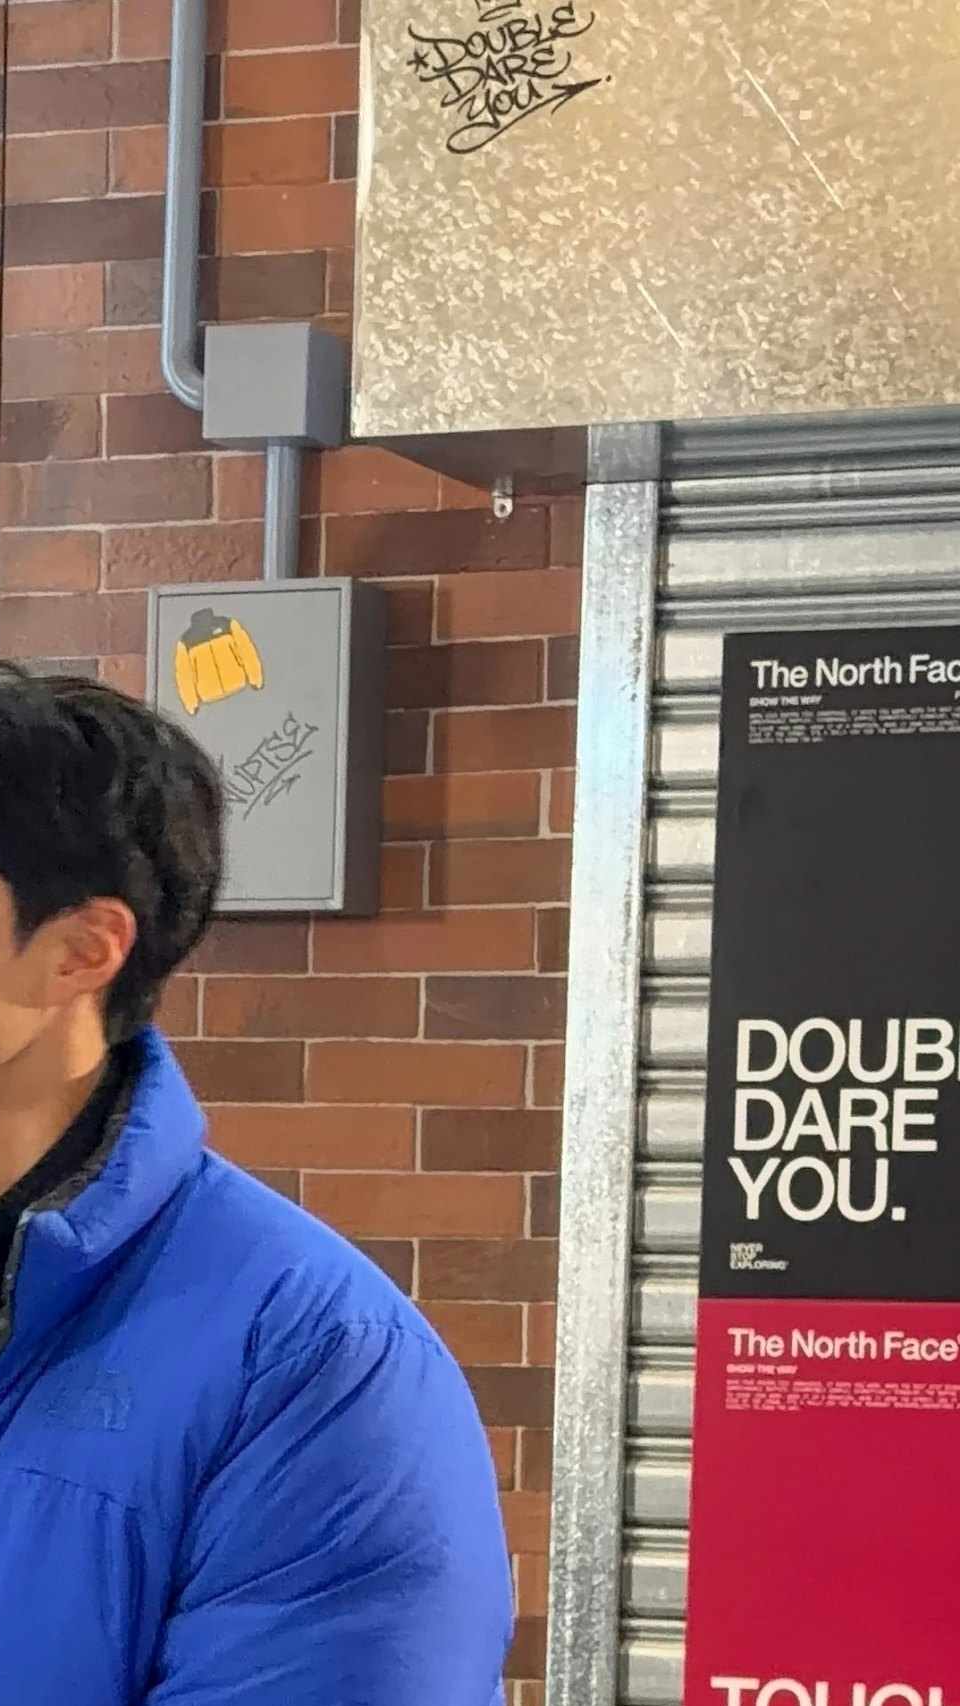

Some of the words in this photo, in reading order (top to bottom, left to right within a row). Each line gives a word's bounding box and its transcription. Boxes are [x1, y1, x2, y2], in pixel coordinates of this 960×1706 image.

[408, 1, 595, 72] DOUBLE
[420, 46, 571, 107] DARE
[750, 659, 809, 689] The
[815, 655, 902, 688] North
[737, 1017, 960, 1083] DOUB
[734, 1087, 939, 1152] DARE
[727, 1155, 907, 1223] YOU.
[727, 1327, 785, 1358] The
[791, 1328, 877, 1359] North
[883, 1330, 958, 1361] Face
